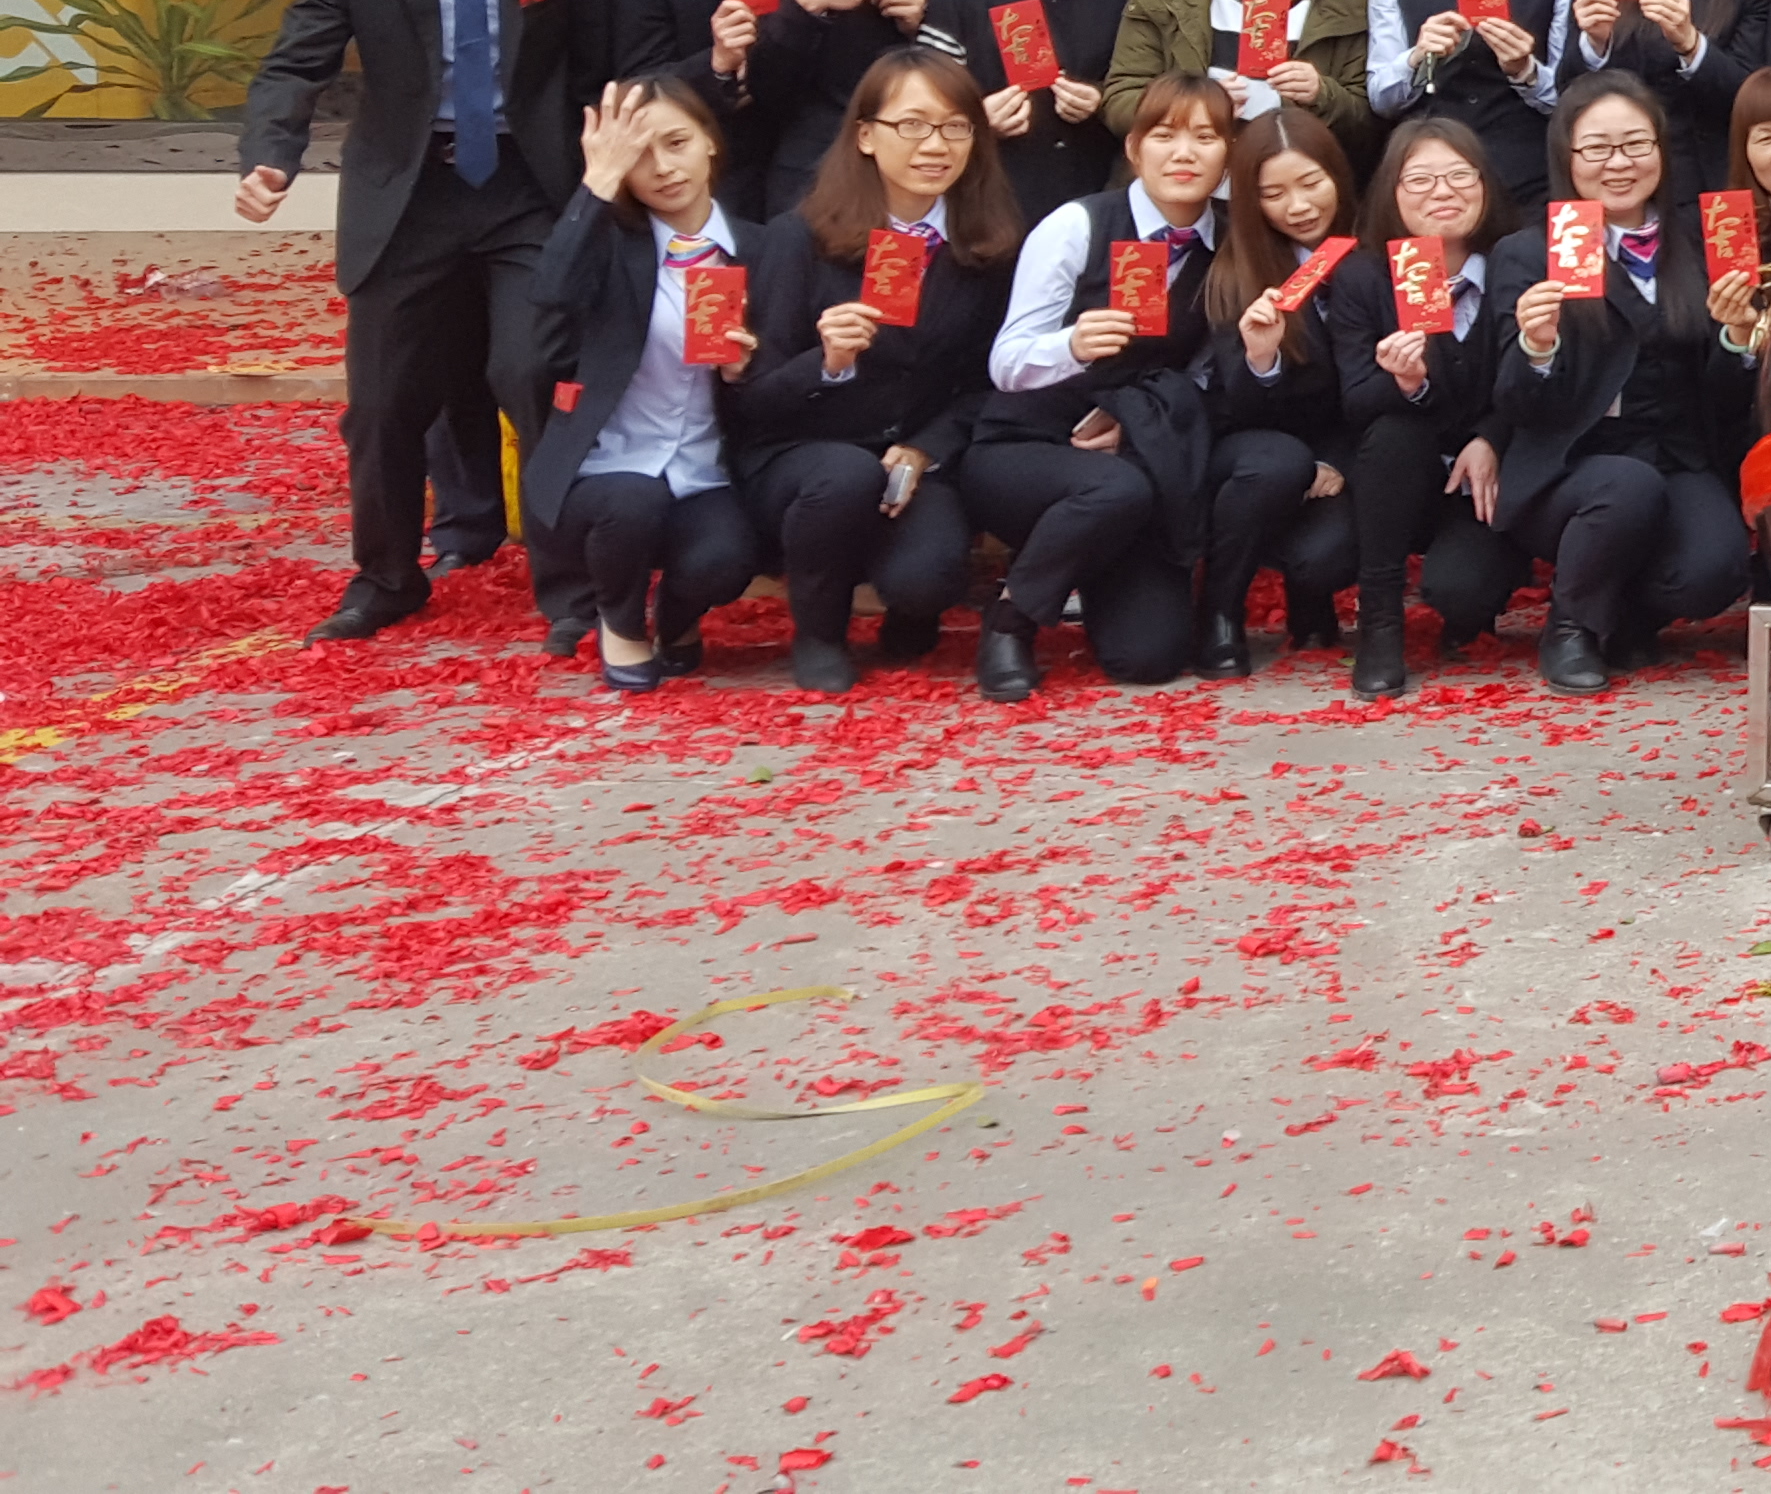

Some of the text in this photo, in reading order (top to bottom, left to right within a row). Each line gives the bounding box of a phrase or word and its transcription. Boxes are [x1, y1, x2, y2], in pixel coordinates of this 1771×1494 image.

[1549, 203, 1590, 269] 大吉
[1703, 195, 1741, 259] 大吉
[868, 234, 907, 295] 大吉
[1111, 244, 1152, 307] 大吉
[1391, 241, 1432, 305] 大吉
[688, 272, 724, 335] 大吉
